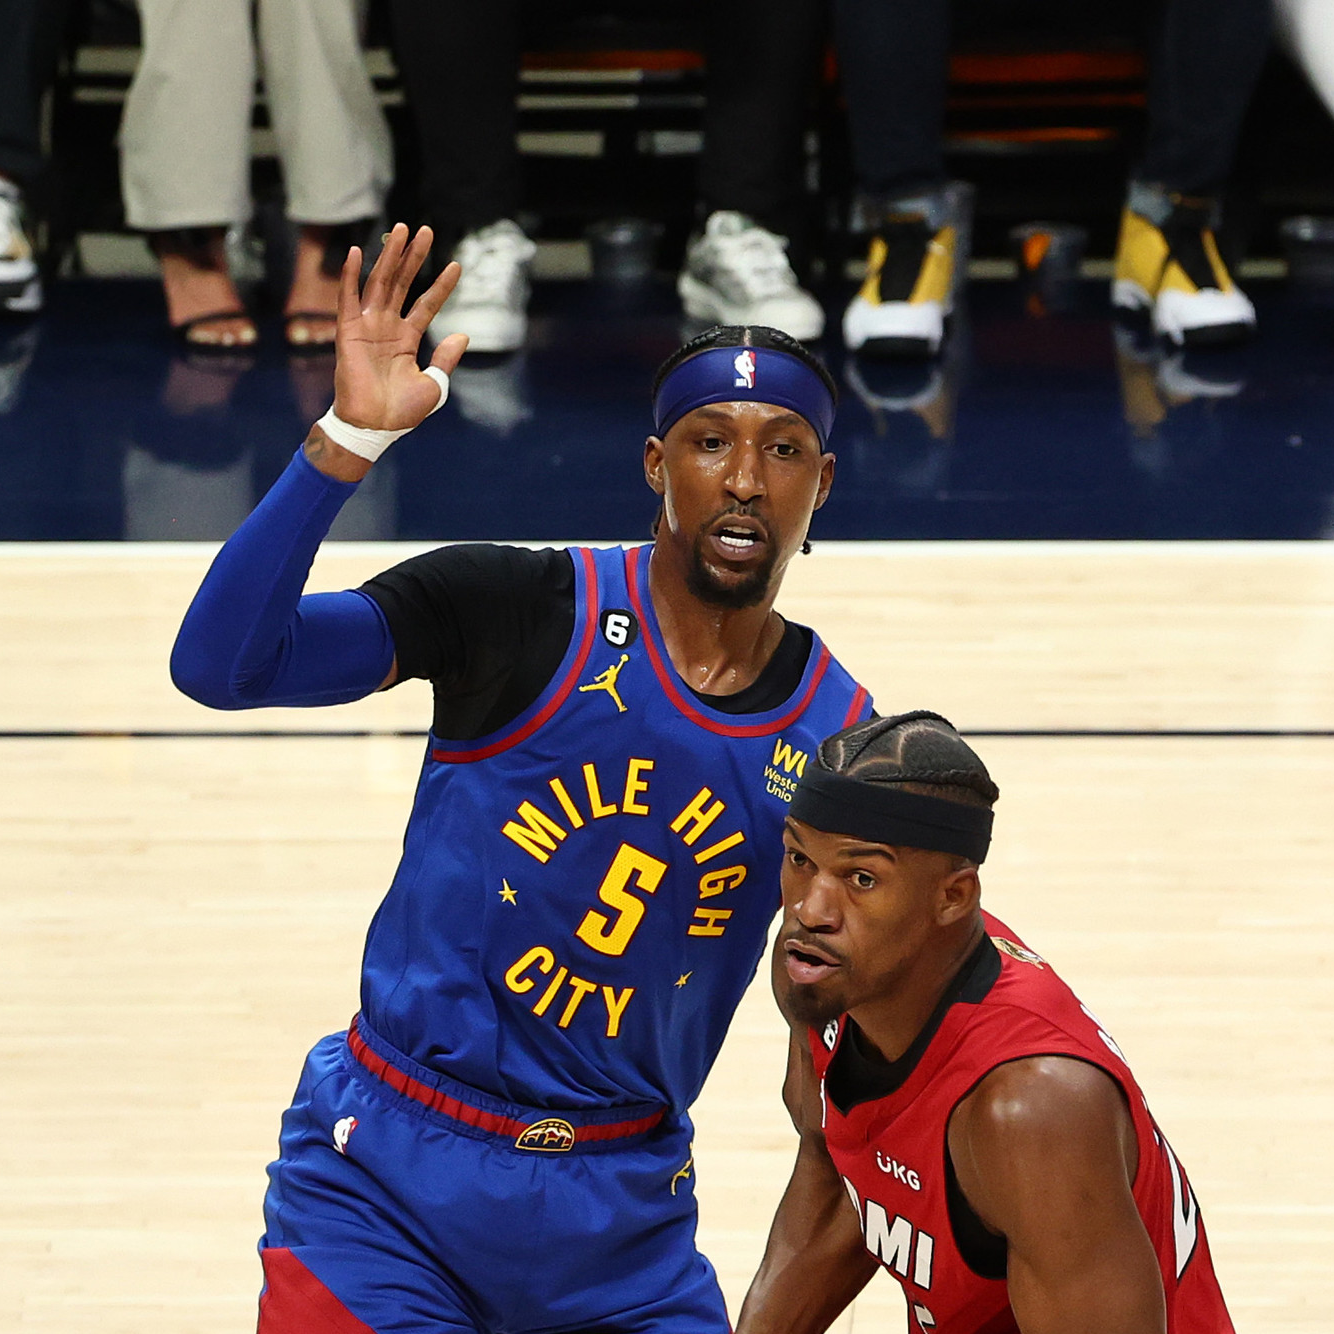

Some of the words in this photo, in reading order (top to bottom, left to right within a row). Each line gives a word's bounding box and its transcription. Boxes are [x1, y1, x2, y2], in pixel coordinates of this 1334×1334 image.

[605, 613, 631, 646] 6
[763, 764, 799, 793] Weste
[765, 780, 793, 804] Unio
[500, 756, 656, 865] MILE
[668, 785, 748, 938] HIGH
[573, 841, 669, 957] 5
[503, 944, 636, 1039] CITY
